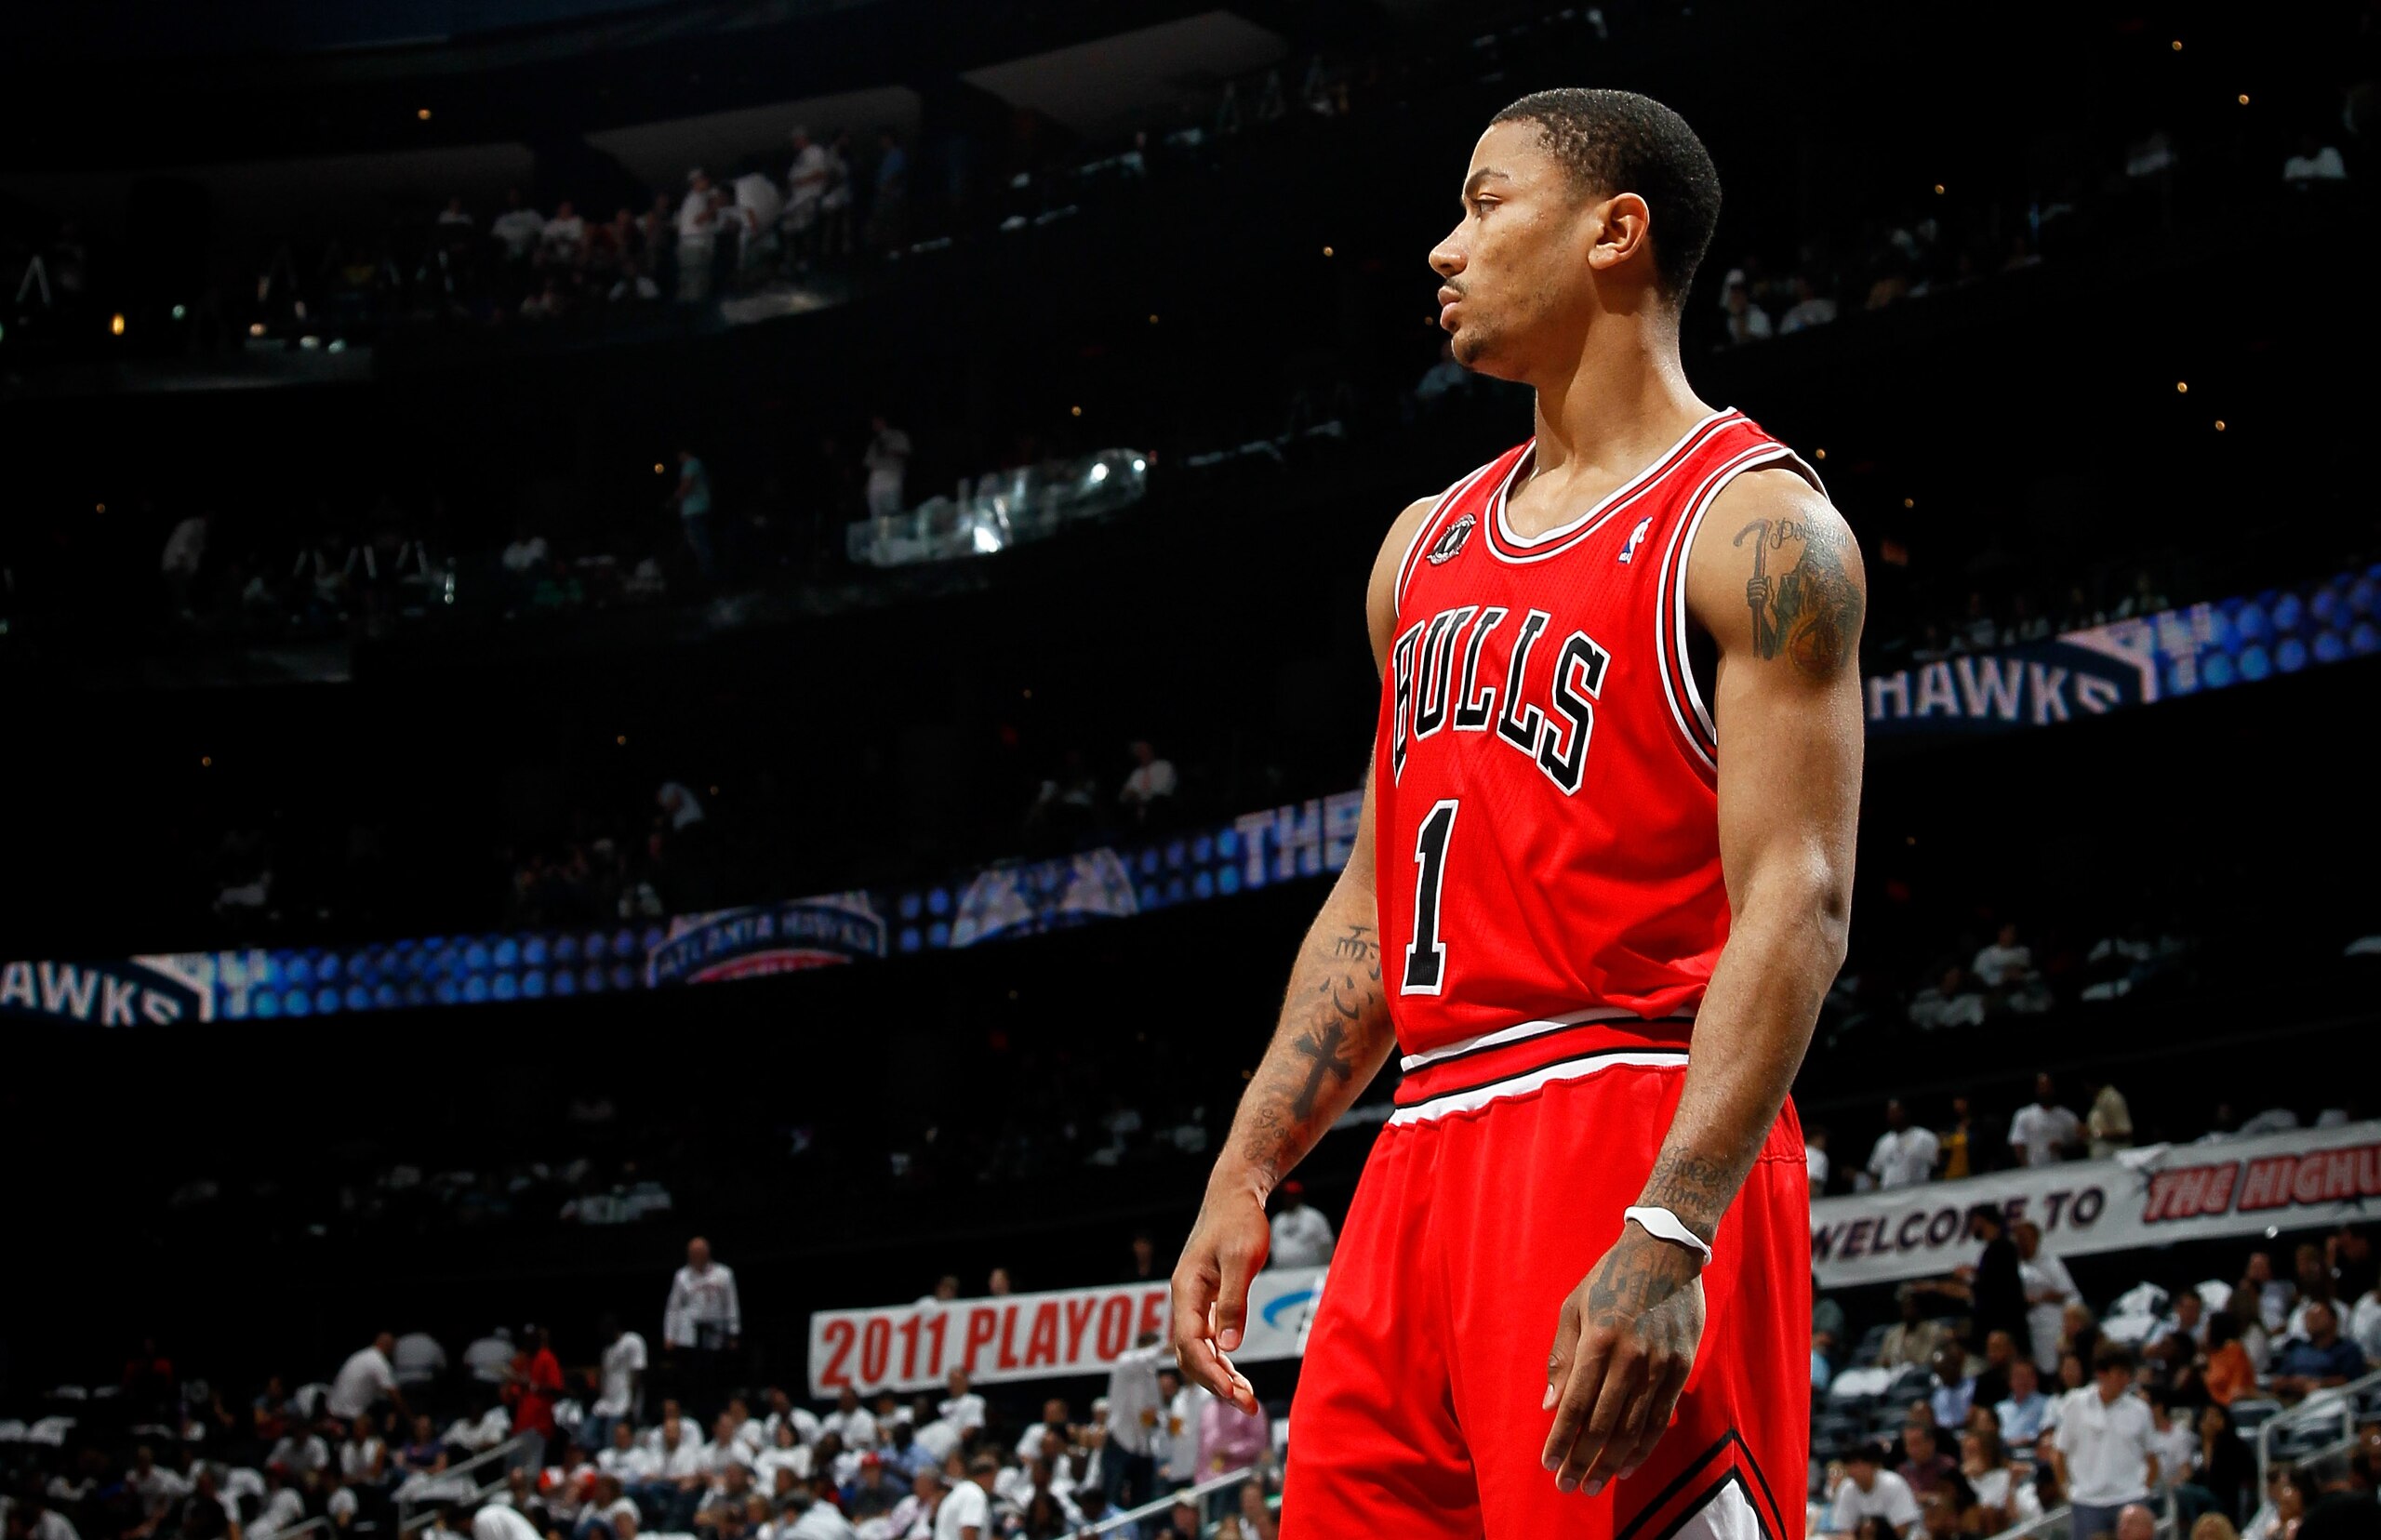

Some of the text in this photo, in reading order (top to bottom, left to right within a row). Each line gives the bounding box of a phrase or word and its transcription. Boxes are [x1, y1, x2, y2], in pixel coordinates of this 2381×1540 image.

[1392, 604, 1611, 797] BULLS
[1400, 799, 1458, 996] 1
[2045, 1187, 2105, 1230] TO
[2143, 1143, 2381, 1224] THE HIGHL
[820, 1291, 1175, 1387] 2011 PLAYOF
